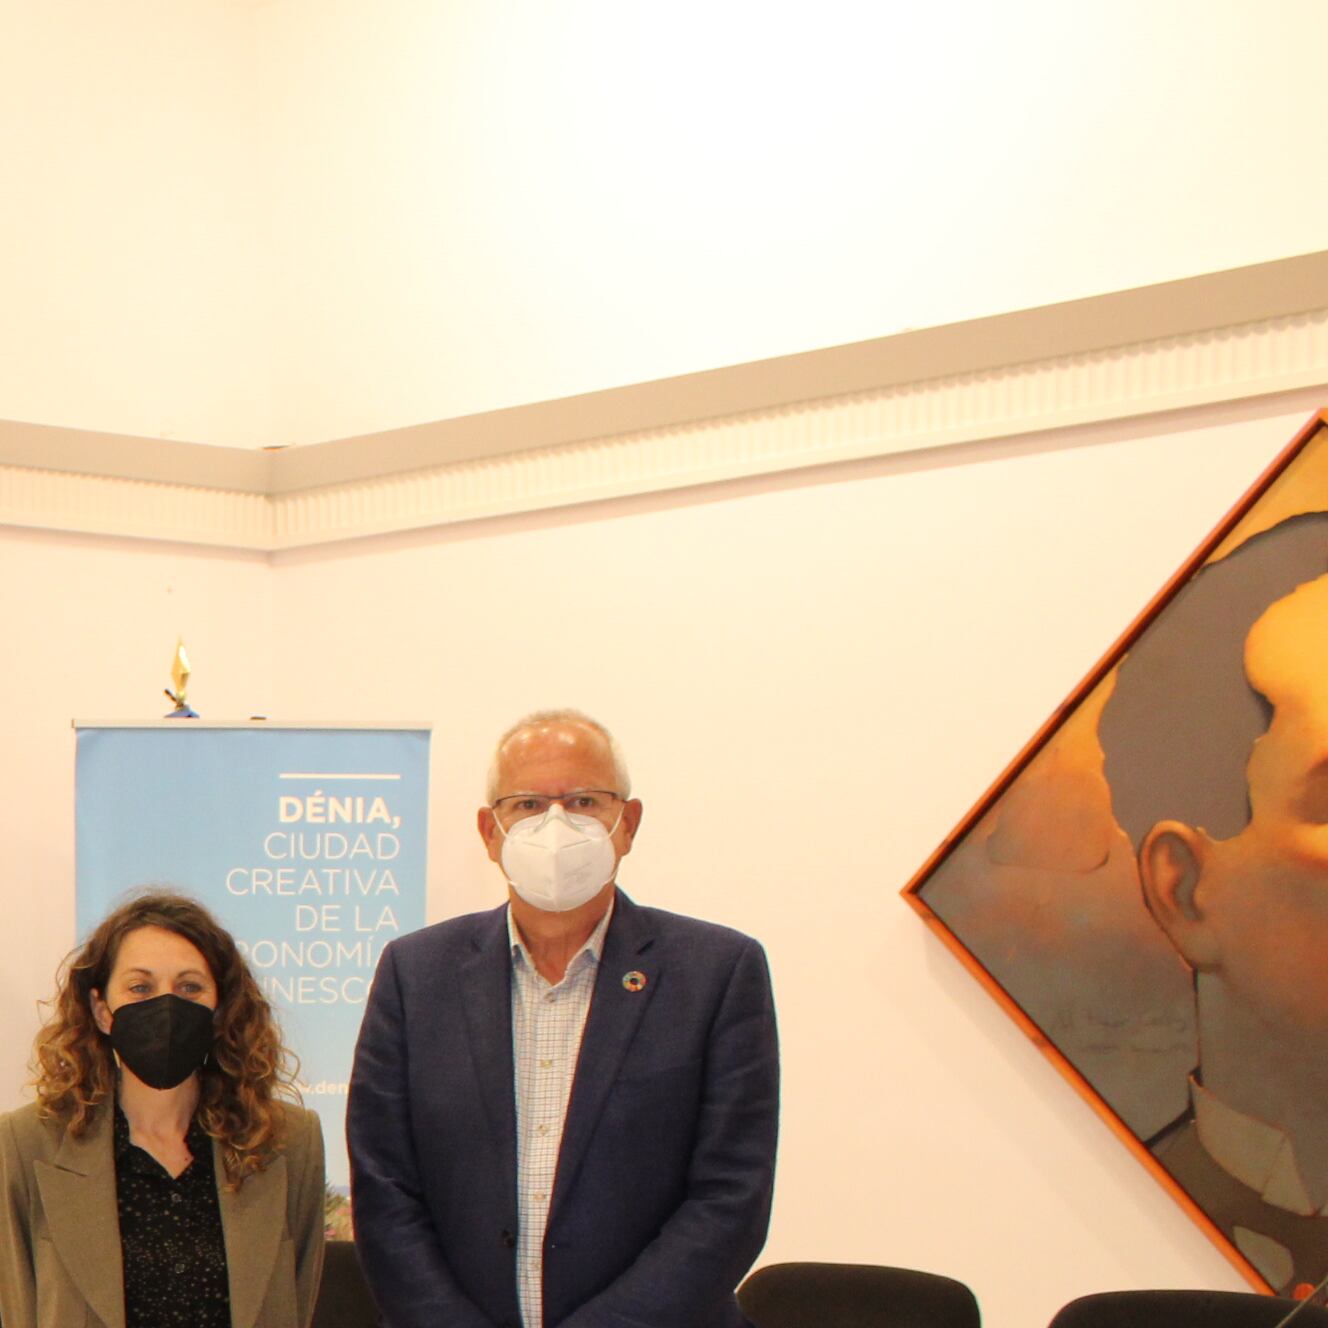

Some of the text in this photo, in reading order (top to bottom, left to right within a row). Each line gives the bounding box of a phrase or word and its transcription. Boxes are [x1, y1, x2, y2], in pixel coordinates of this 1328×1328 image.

[279, 790, 401, 829] DÉNIA,
[264, 832, 400, 860] CIUDAD
[226, 868, 400, 896] CREATIVA
[296, 905, 399, 932] DE LA
